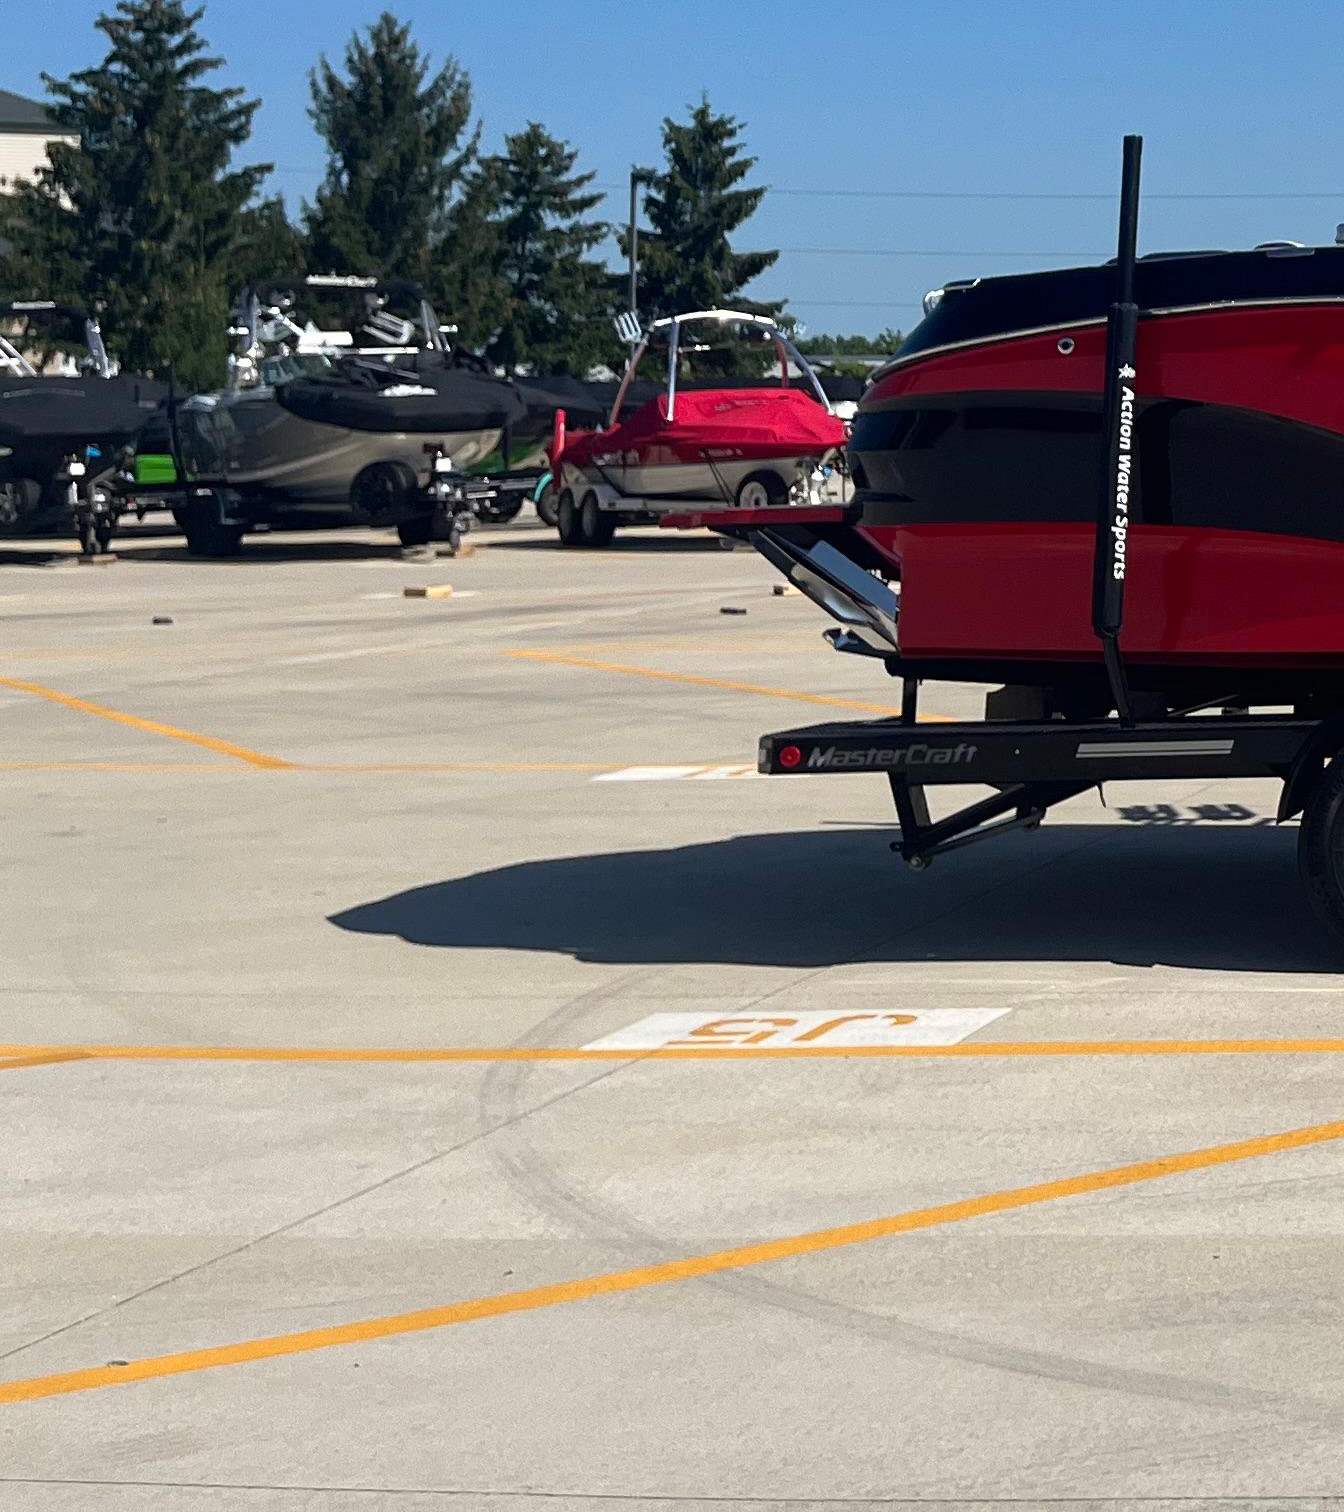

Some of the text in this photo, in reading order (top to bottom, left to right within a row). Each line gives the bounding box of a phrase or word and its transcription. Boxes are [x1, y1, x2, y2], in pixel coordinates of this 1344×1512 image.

[1111, 386, 1135, 581] Action Water Sports
[807, 743, 978, 768] MasterCraft
[666, 1014, 919, 1046] J5
